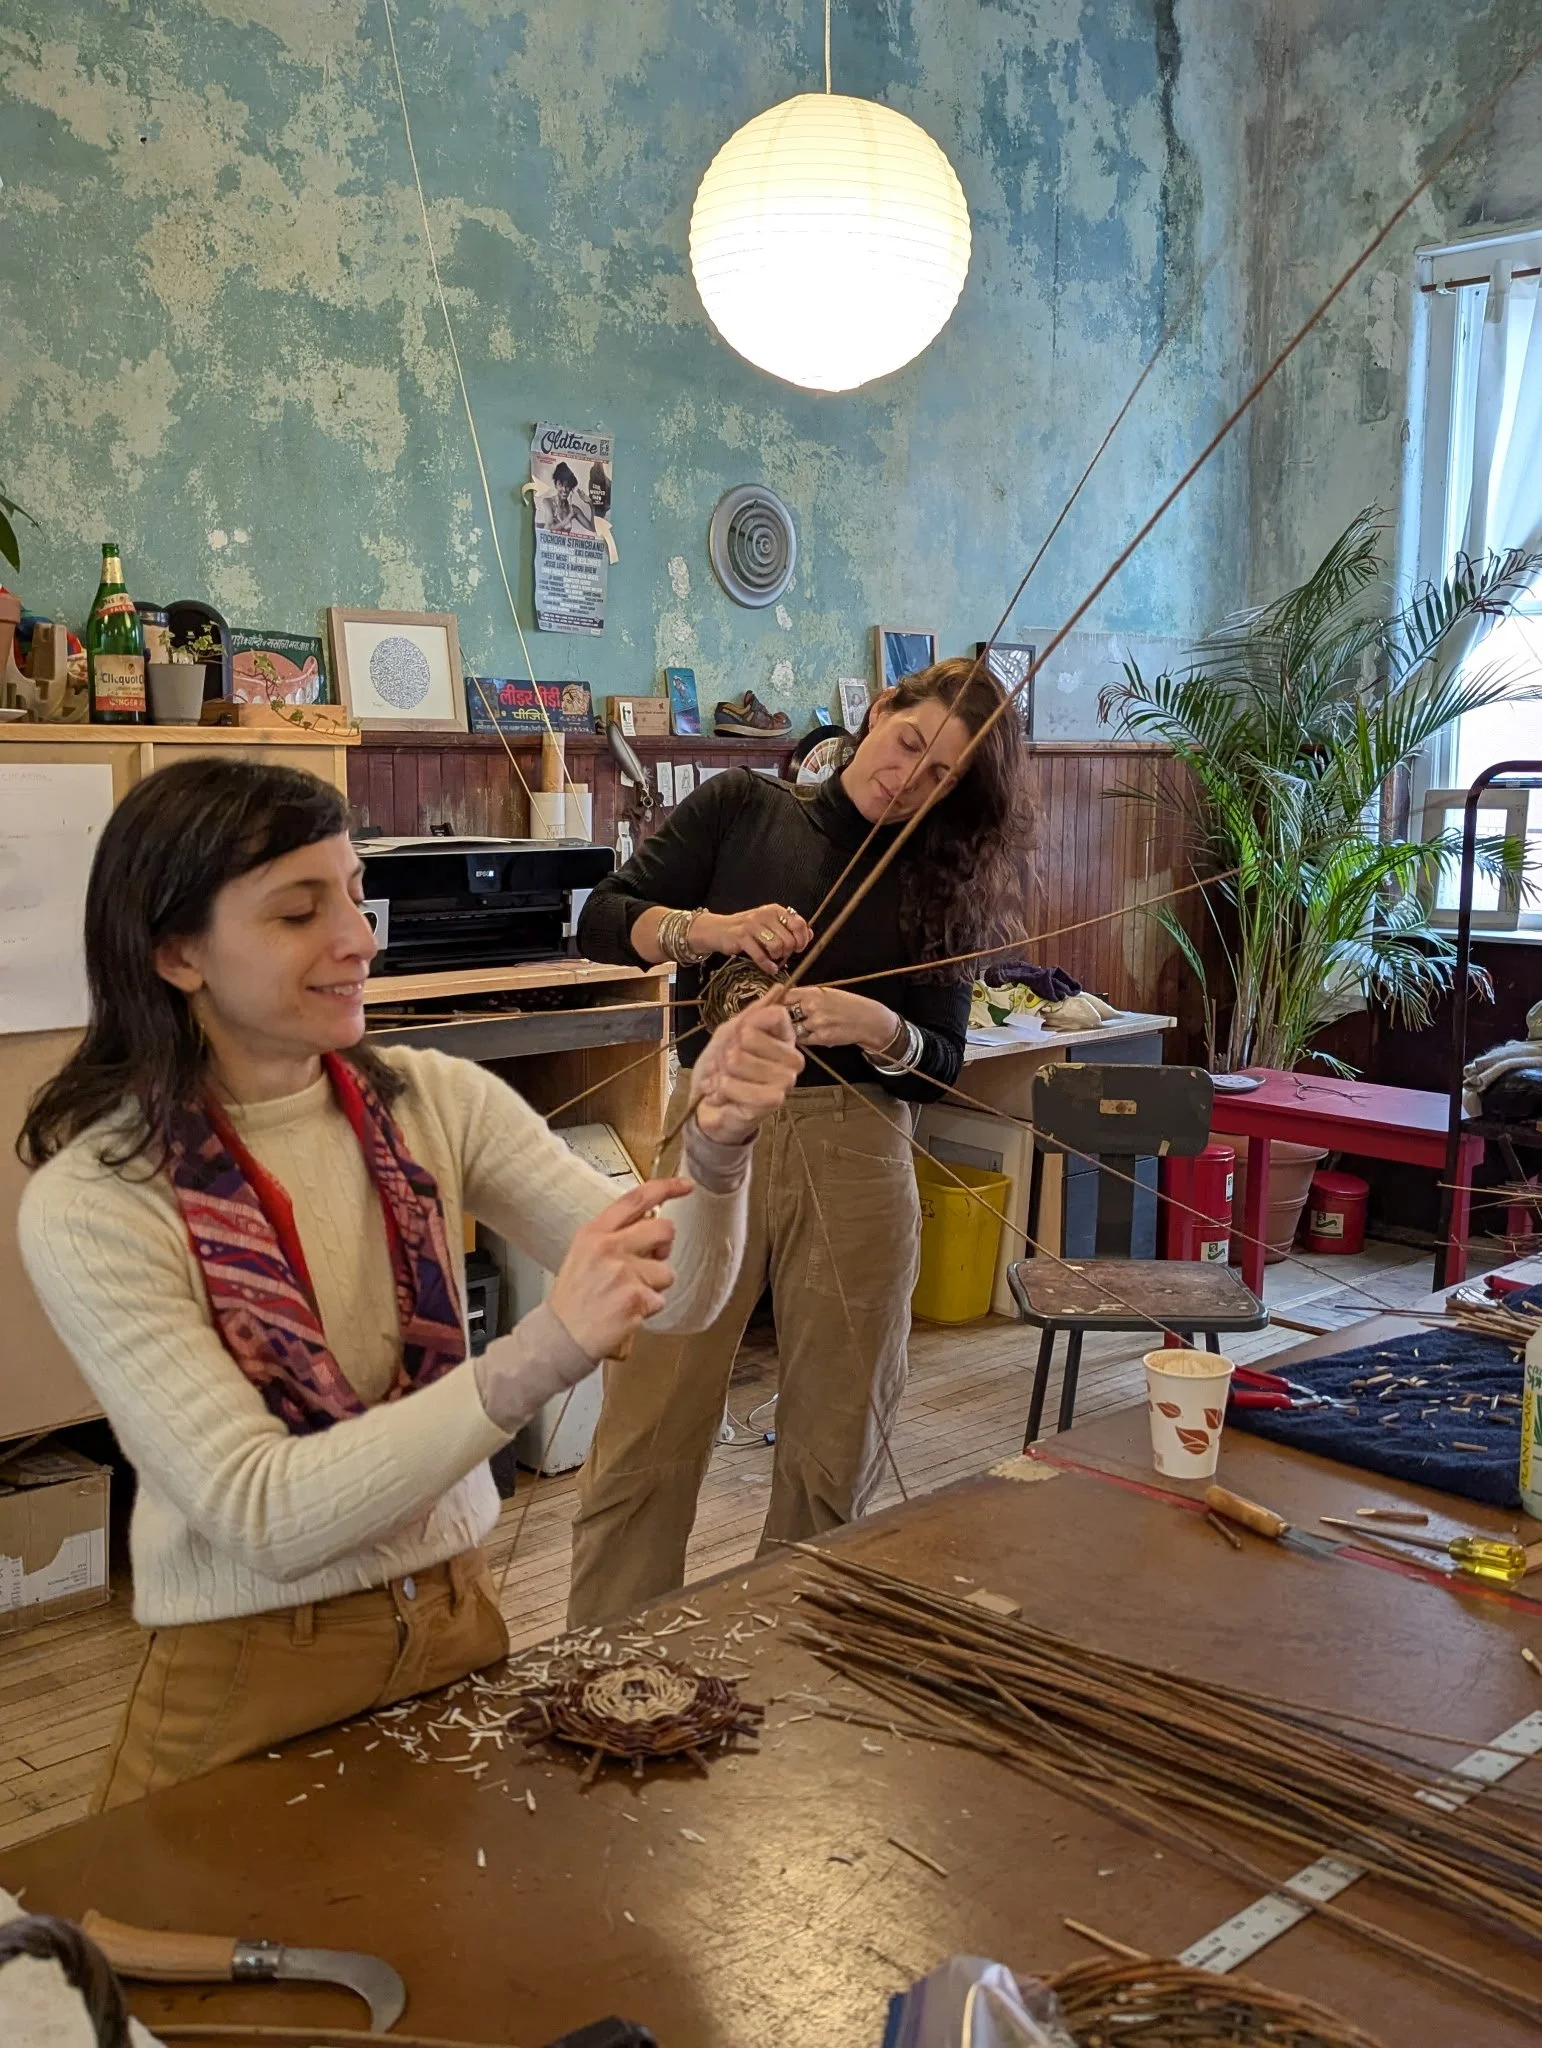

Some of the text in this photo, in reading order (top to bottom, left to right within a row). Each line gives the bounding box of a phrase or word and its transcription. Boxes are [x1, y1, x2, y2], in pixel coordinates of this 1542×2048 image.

[541, 429, 598, 454] Oldtone
[540, 533, 566, 546] FOGHORN
[566, 537, 605, 552] STRINGBAND
[500, 683, 532, 707] लीडर
